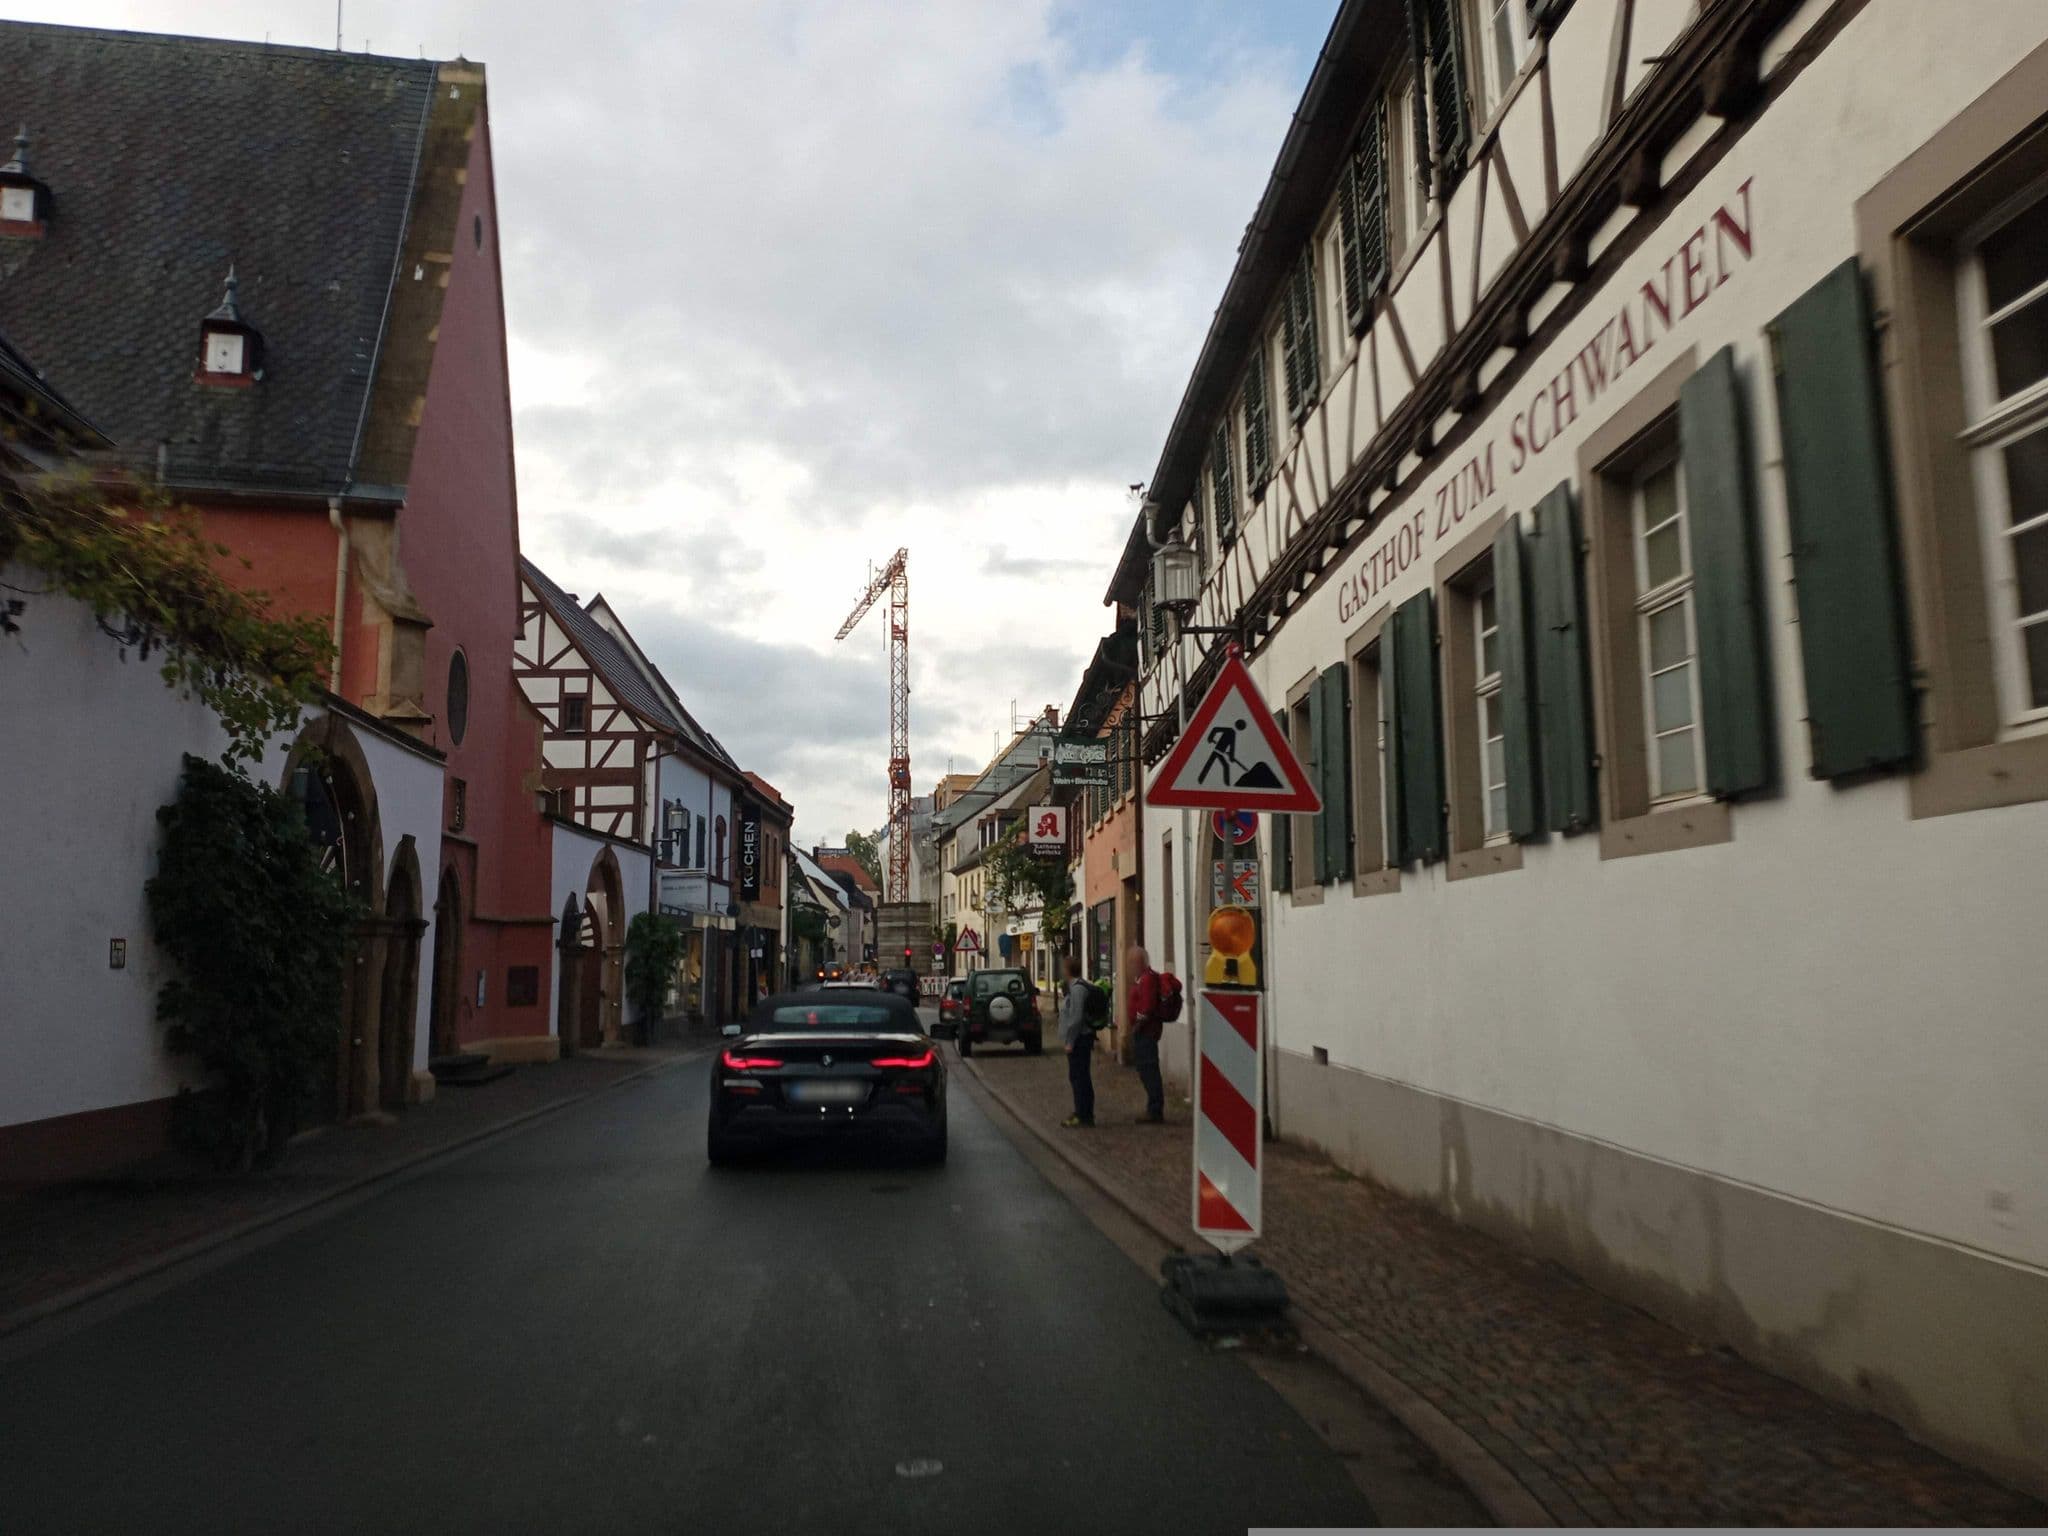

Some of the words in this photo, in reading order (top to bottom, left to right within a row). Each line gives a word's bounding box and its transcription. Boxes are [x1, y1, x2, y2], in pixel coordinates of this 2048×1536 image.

[1337, 508, 1426, 624] GASTHOF
[1434, 440, 1496, 543] ZUM
[1510, 175, 1757, 476] SCHWANEN
